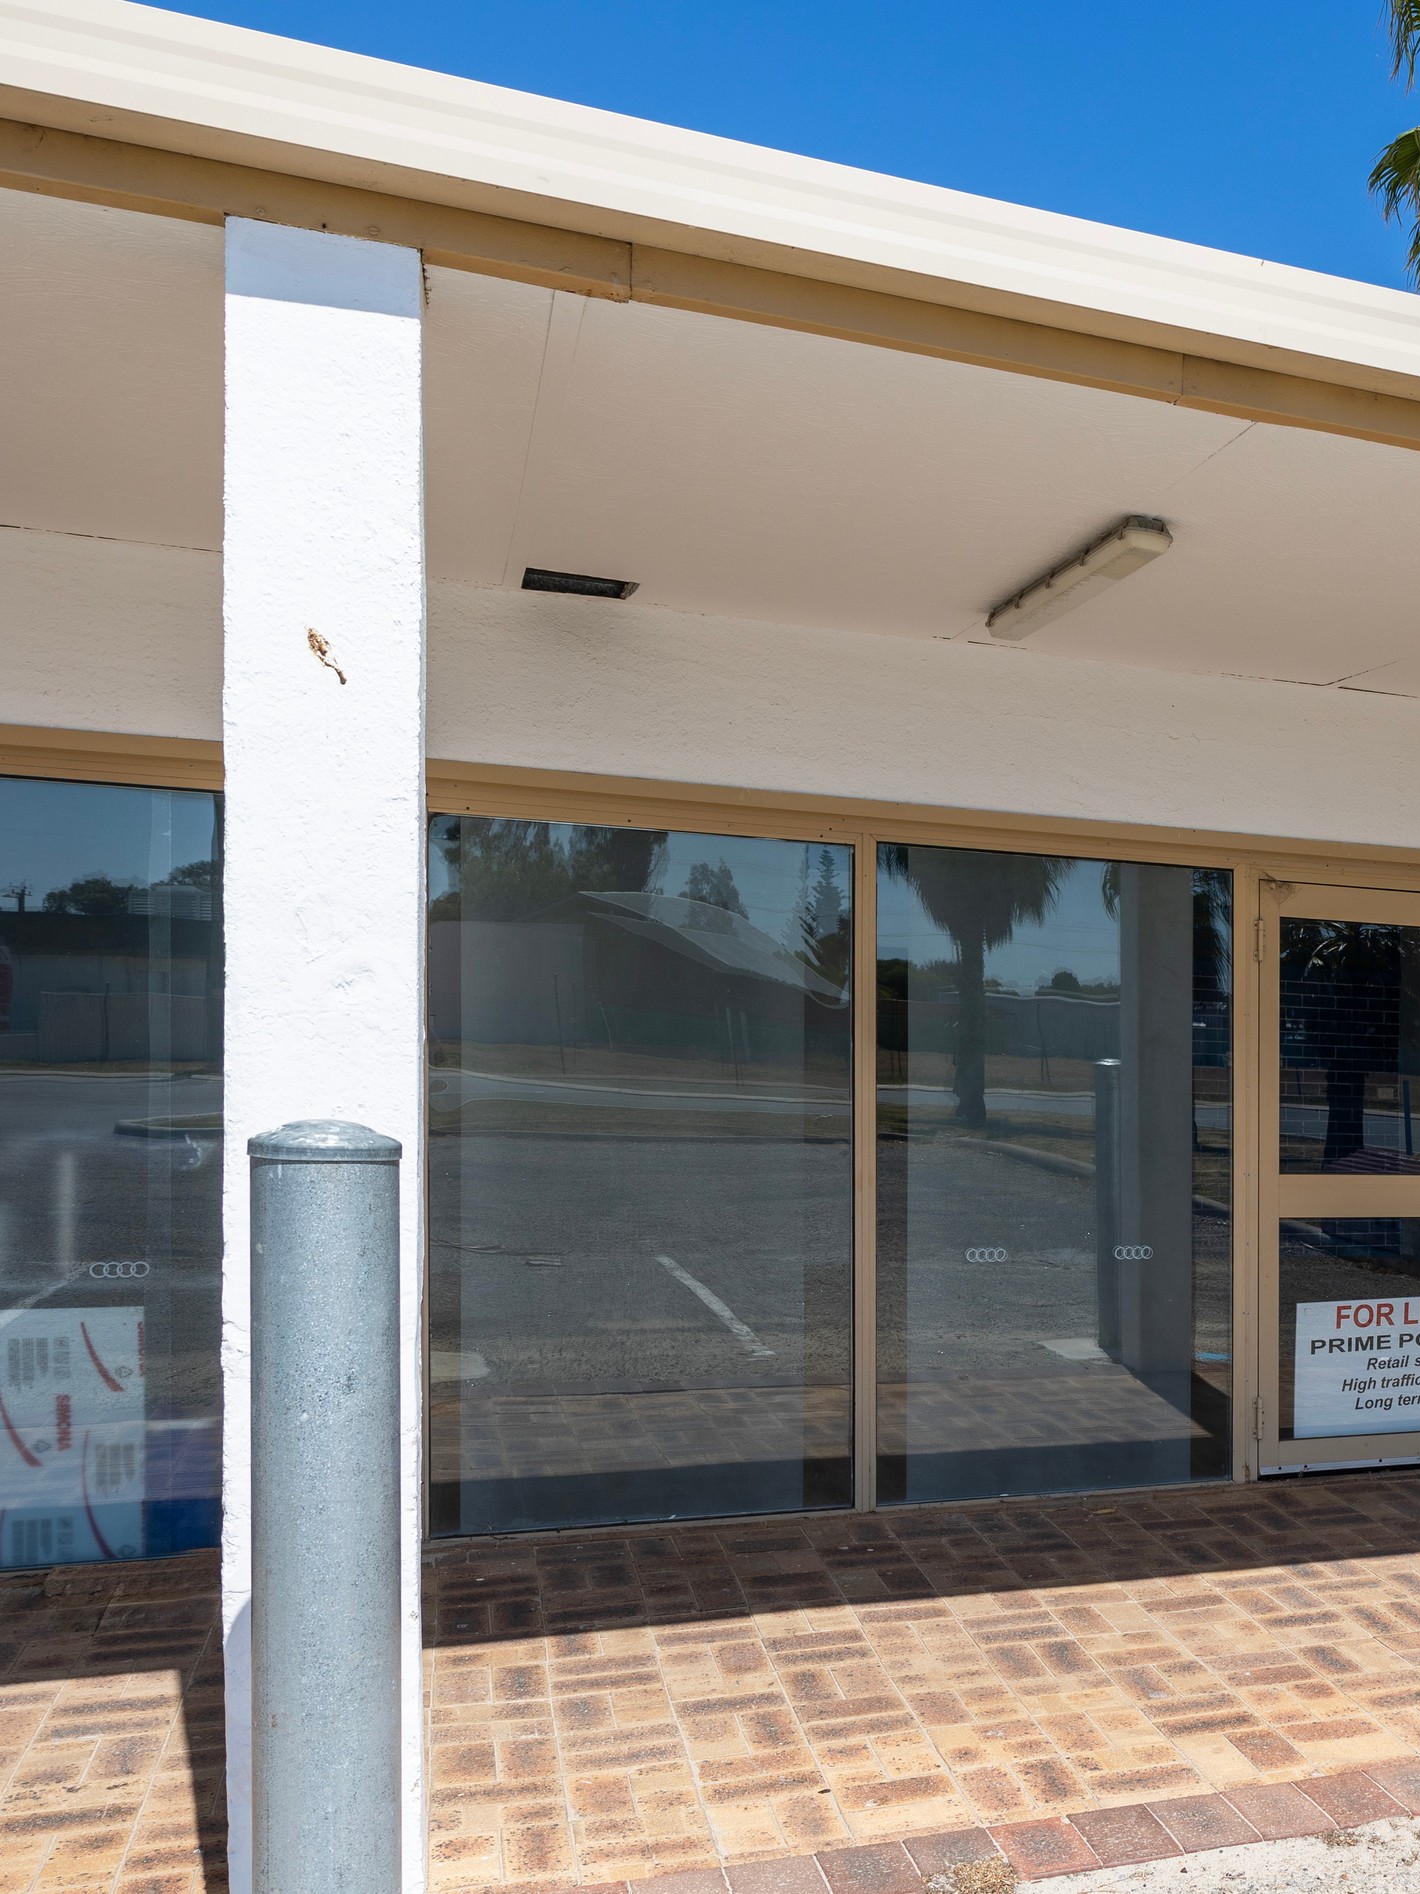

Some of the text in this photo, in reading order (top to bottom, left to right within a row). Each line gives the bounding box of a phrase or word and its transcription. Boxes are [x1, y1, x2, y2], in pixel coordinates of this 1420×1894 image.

[1335, 1302, 1394, 1329] FOR
[1310, 1334, 1392, 1355] PRIME
[1366, 1355, 1409, 1371] Retail
[1341, 1378, 1377, 1393] High
[1355, 1397, 1393, 1411] Long
